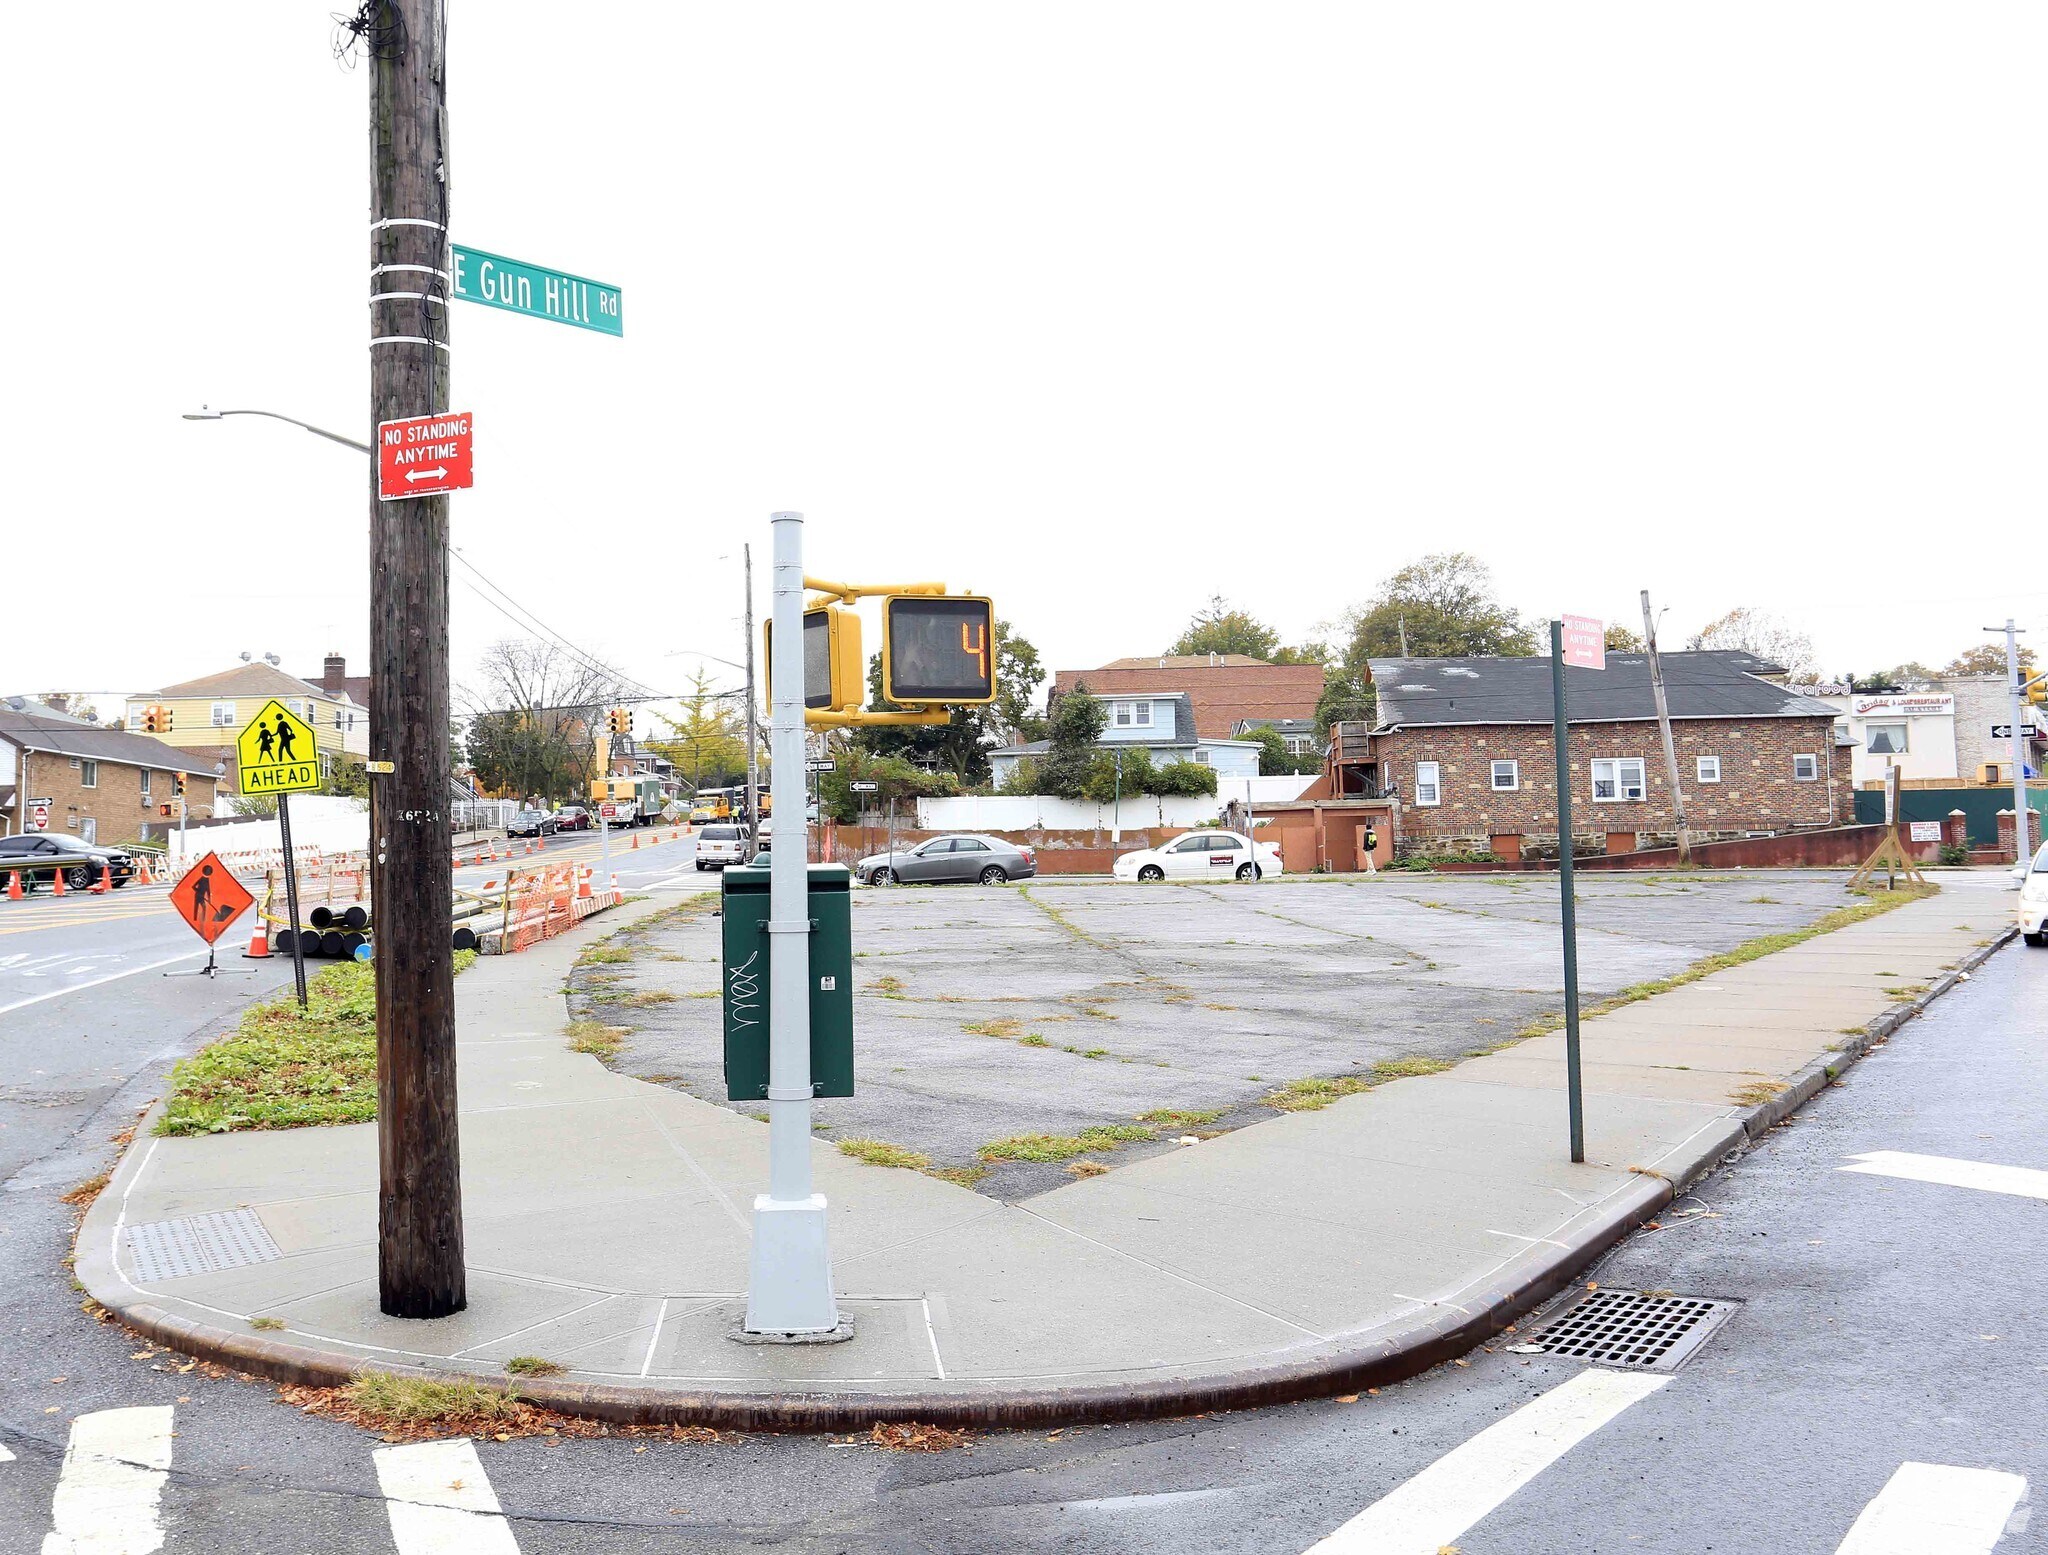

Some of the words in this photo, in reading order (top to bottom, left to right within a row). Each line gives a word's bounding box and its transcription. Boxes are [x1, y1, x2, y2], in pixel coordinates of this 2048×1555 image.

[453, 253, 467, 294] E
[480, 260, 532, 310] Gun
[544, 276, 590, 324] Hill
[599, 291, 618, 317] Rd
[384, 428, 402, 446] NO
[407, 419, 468, 443] STANDING
[394, 441, 459, 466] ANYTIME
[1565, 618, 1573, 630] NO
[961, 621, 986, 679] 4
[1570, 634, 1598, 647] ANYTIME
[251, 767, 311, 787] AHEAD
